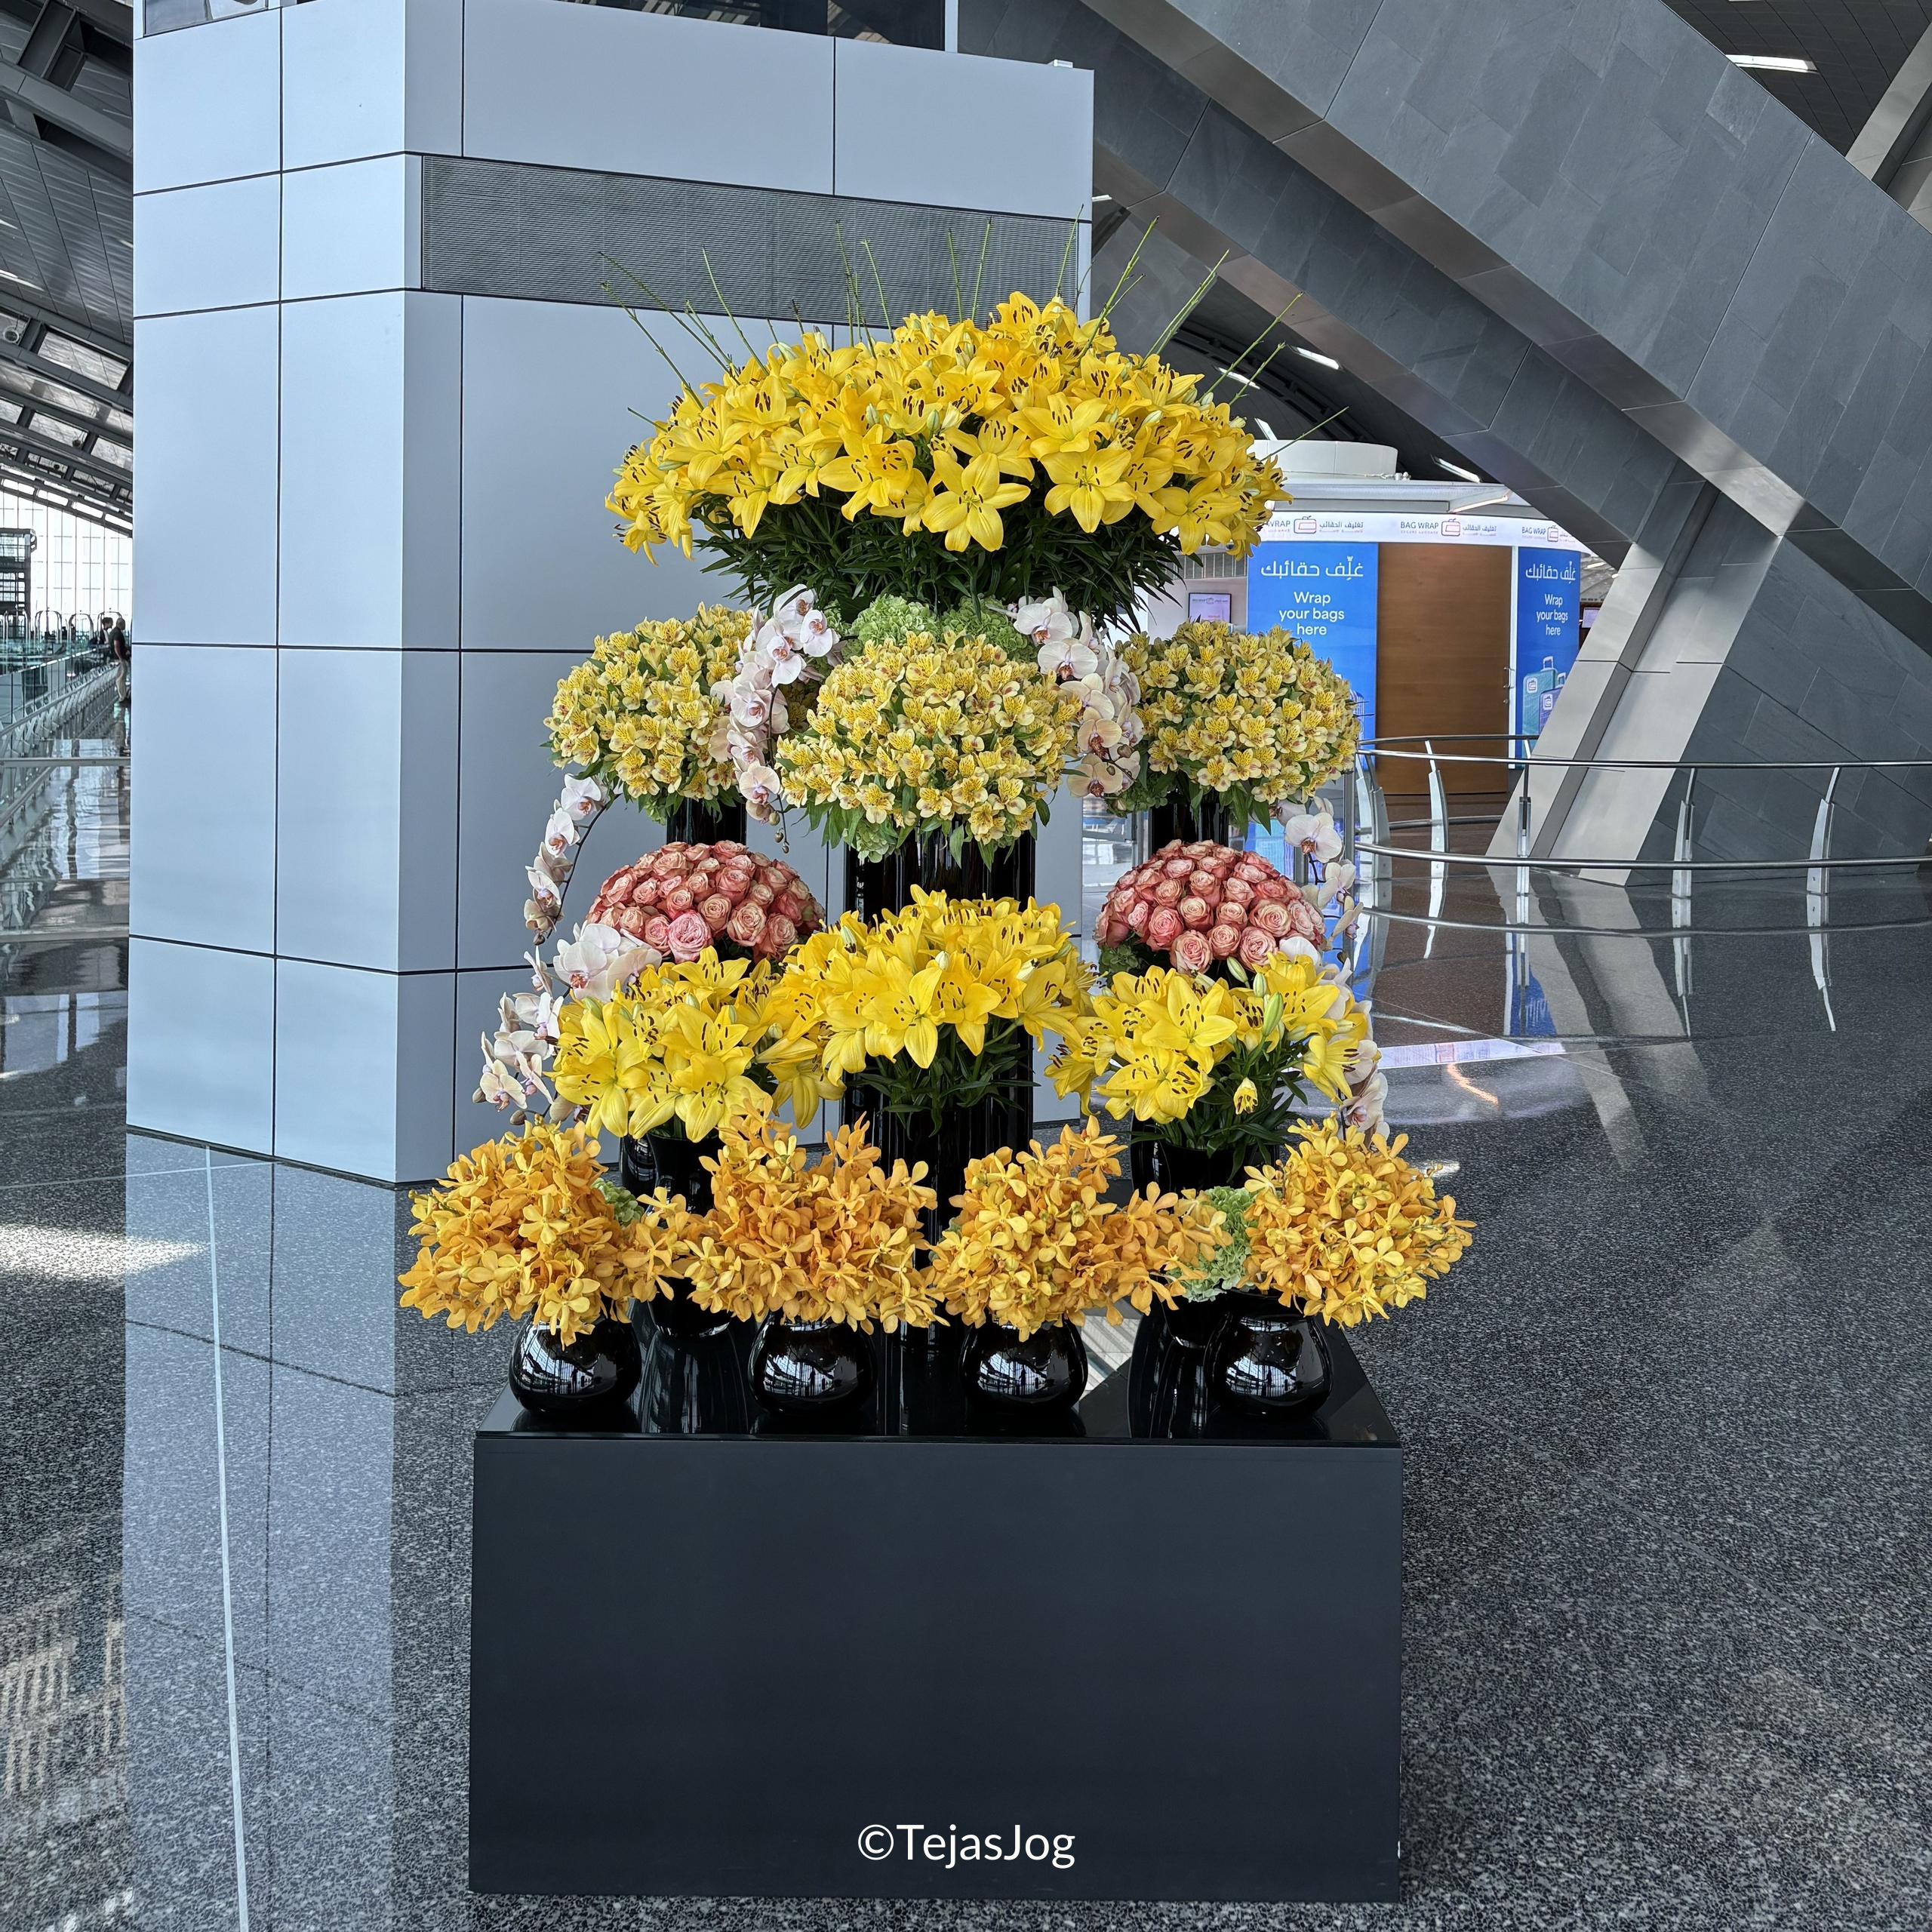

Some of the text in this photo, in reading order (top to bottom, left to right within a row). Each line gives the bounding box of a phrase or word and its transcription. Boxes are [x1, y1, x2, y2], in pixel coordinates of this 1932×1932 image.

[1400, 521, 1417, 529] BAG
[1260, 560, 1320, 579] حقائبك
[1525, 563, 1558, 581] حقائبك
[1294, 591, 1331, 606] Wrap
[1544, 593, 1563, 608] Wrap
[1278, 607, 1345, 623] your bags
[1536, 609, 1568, 623] your bags
[1297, 623, 1327, 635] here
[1546, 624, 1561, 635] here
